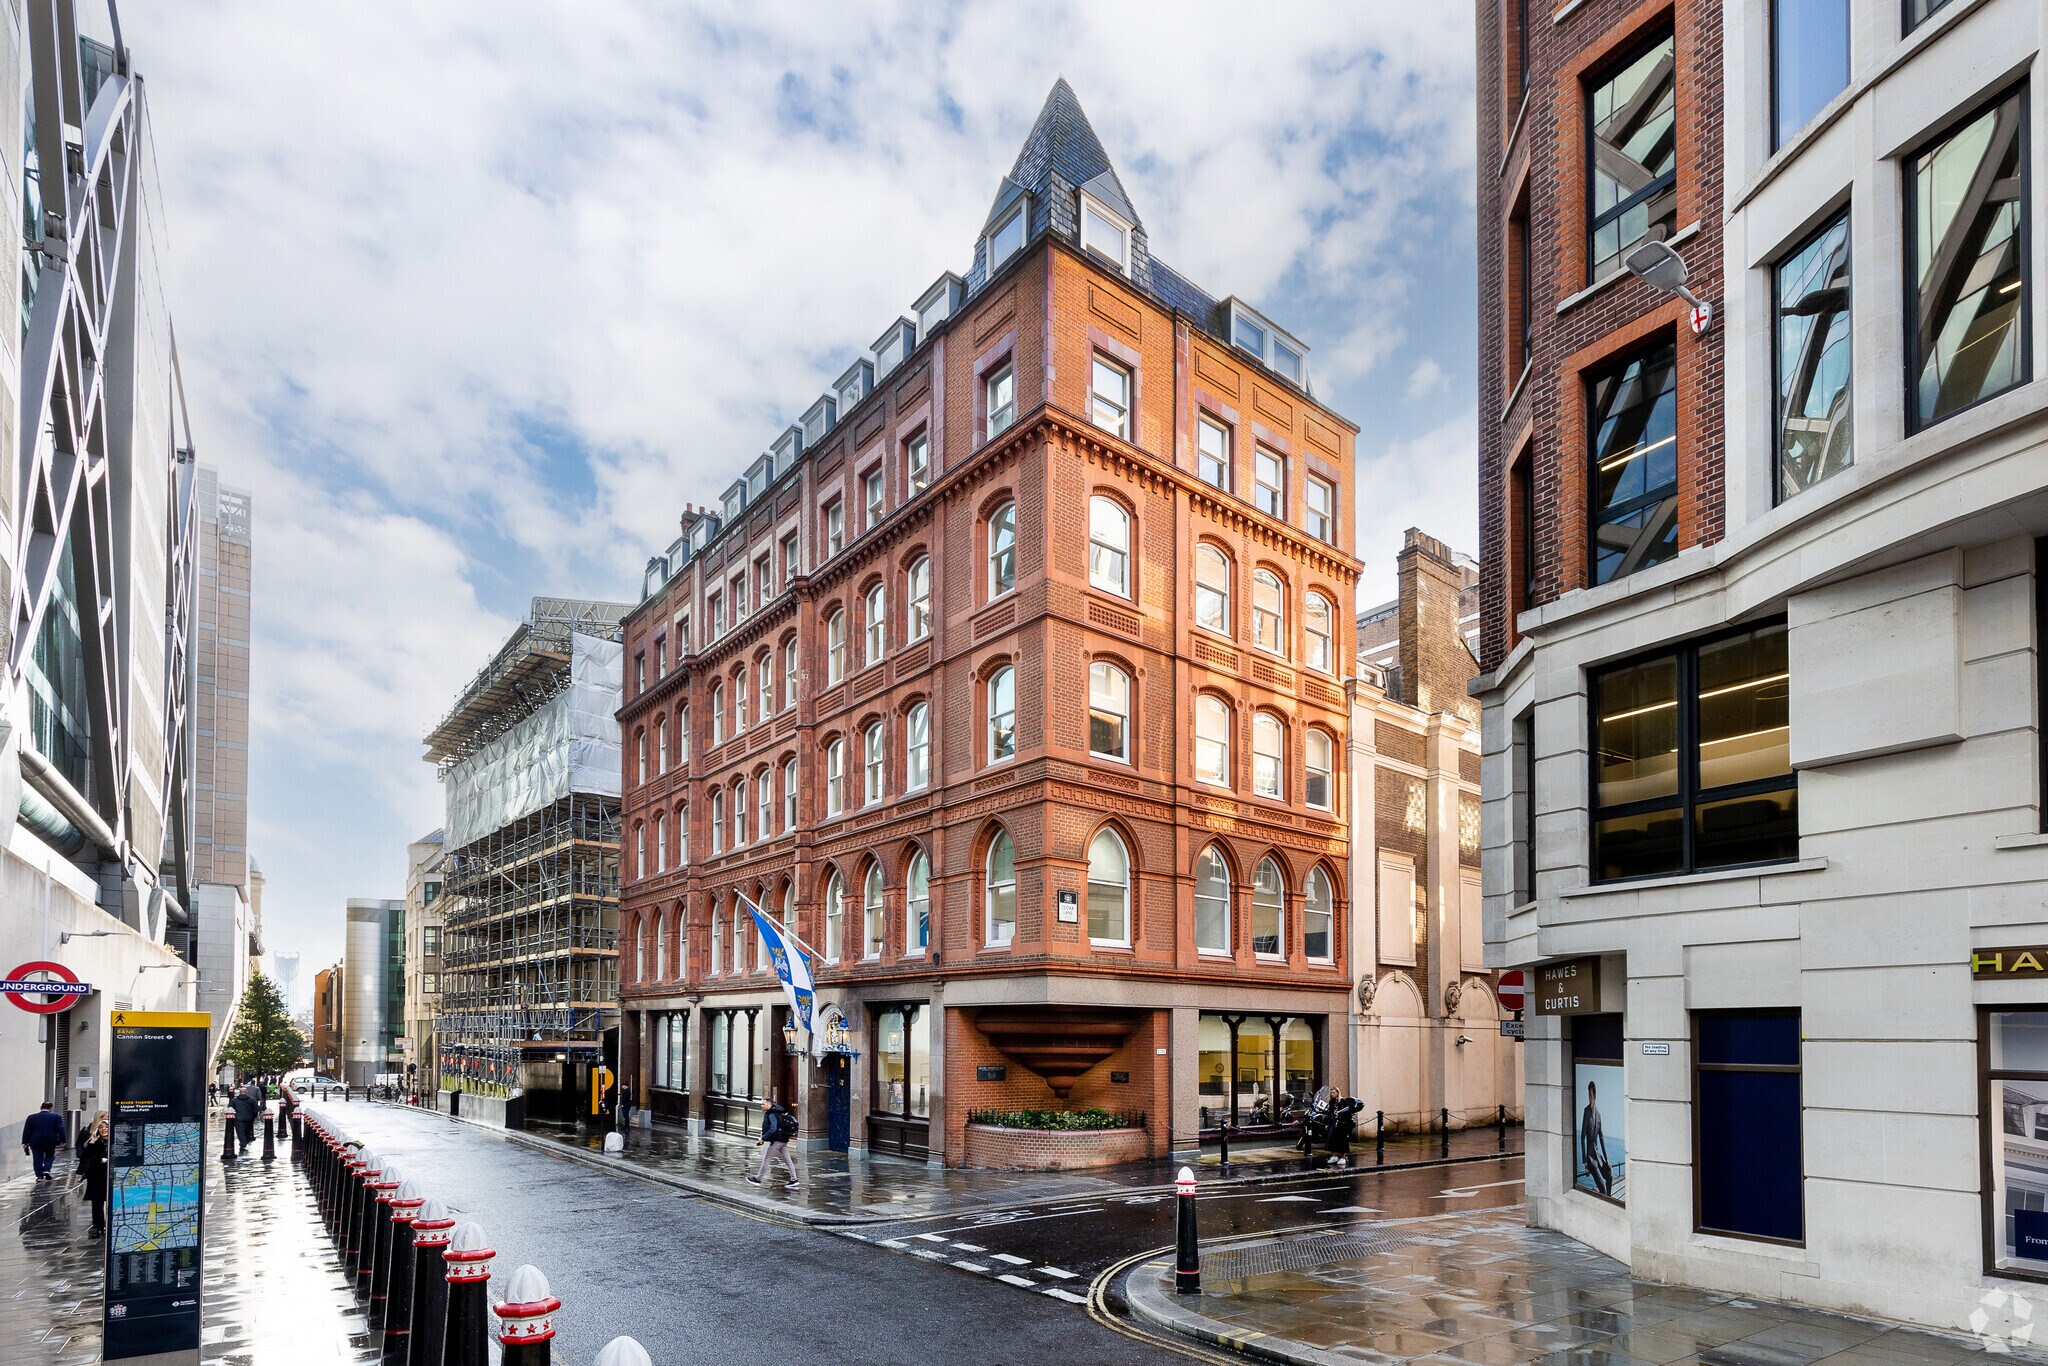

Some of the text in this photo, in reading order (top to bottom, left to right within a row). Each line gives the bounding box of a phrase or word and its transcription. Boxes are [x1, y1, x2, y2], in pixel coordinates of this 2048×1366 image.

[1972, 951, 2048, 973] HA
[1545, 965, 1577, 981] HAWES
[0, 982, 87, 992] UNDERGROUND
[1558, 982, 1564, 994] &
[1545, 995, 1580, 1010] CURTIS
[2025, 1235, 2048, 1245] From
